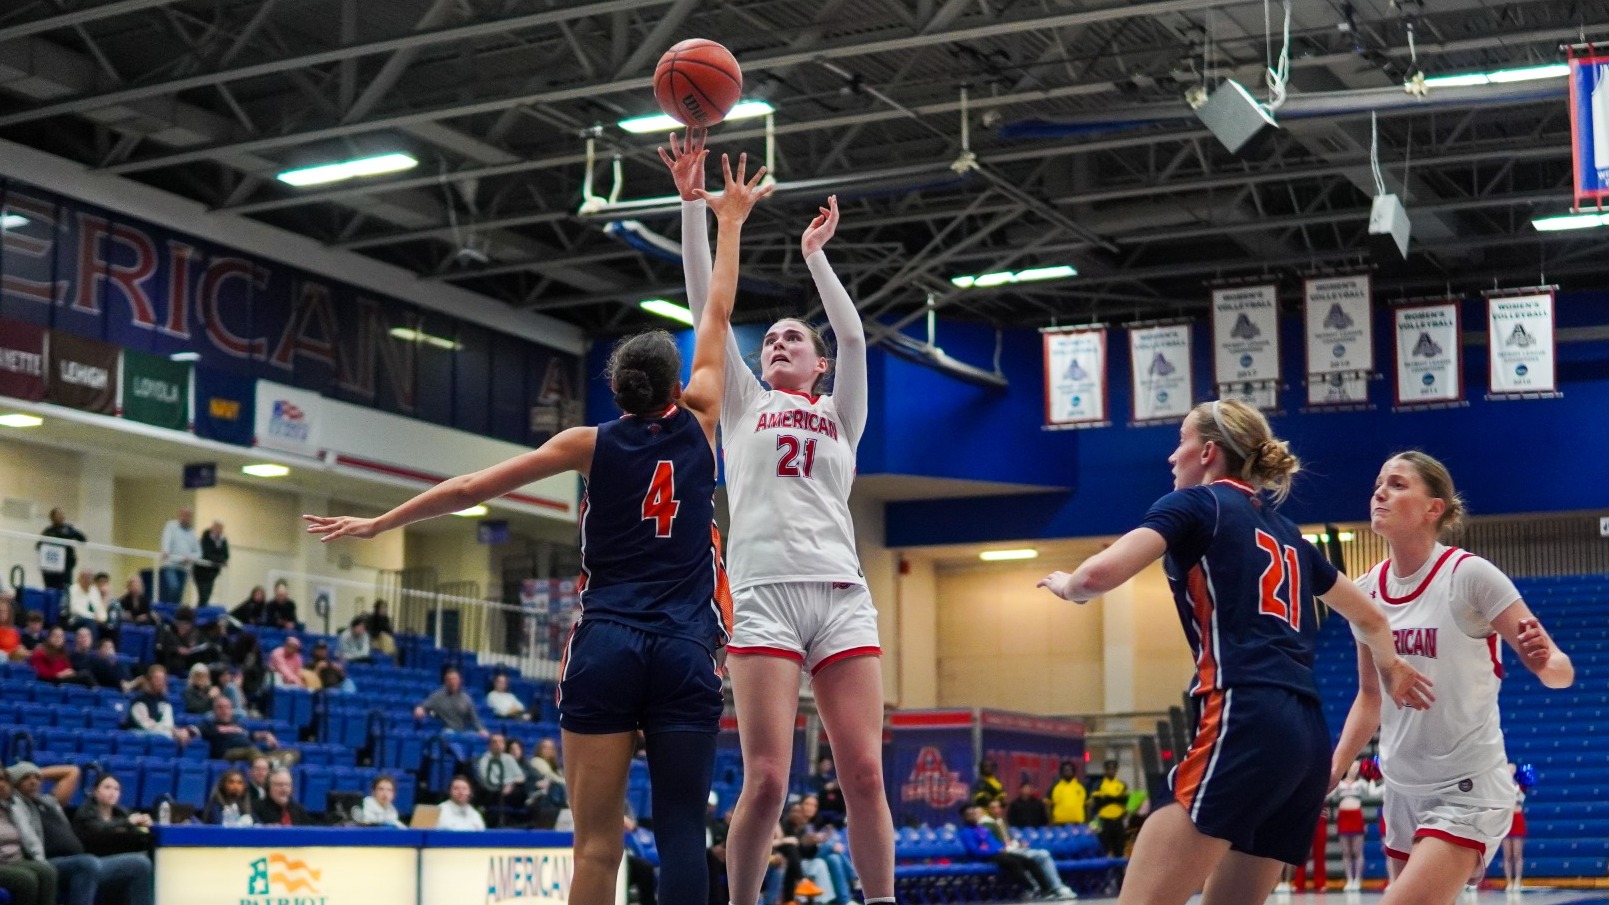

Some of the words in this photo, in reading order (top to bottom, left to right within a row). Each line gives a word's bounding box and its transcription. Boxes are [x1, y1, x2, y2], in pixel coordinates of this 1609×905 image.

[1404, 311, 1445, 320] WOMEN'S
[1492, 311, 1547, 320] VOLLEYBALL
[1498, 302, 1539, 310] WOMEN'S
[1399, 320, 1453, 330] VOLLEYBALL
[754, 409, 838, 443] AMERICAN
[776, 434, 817, 480] 21
[641, 460, 680, 538] 4
[1255, 528, 1300, 632] 21
